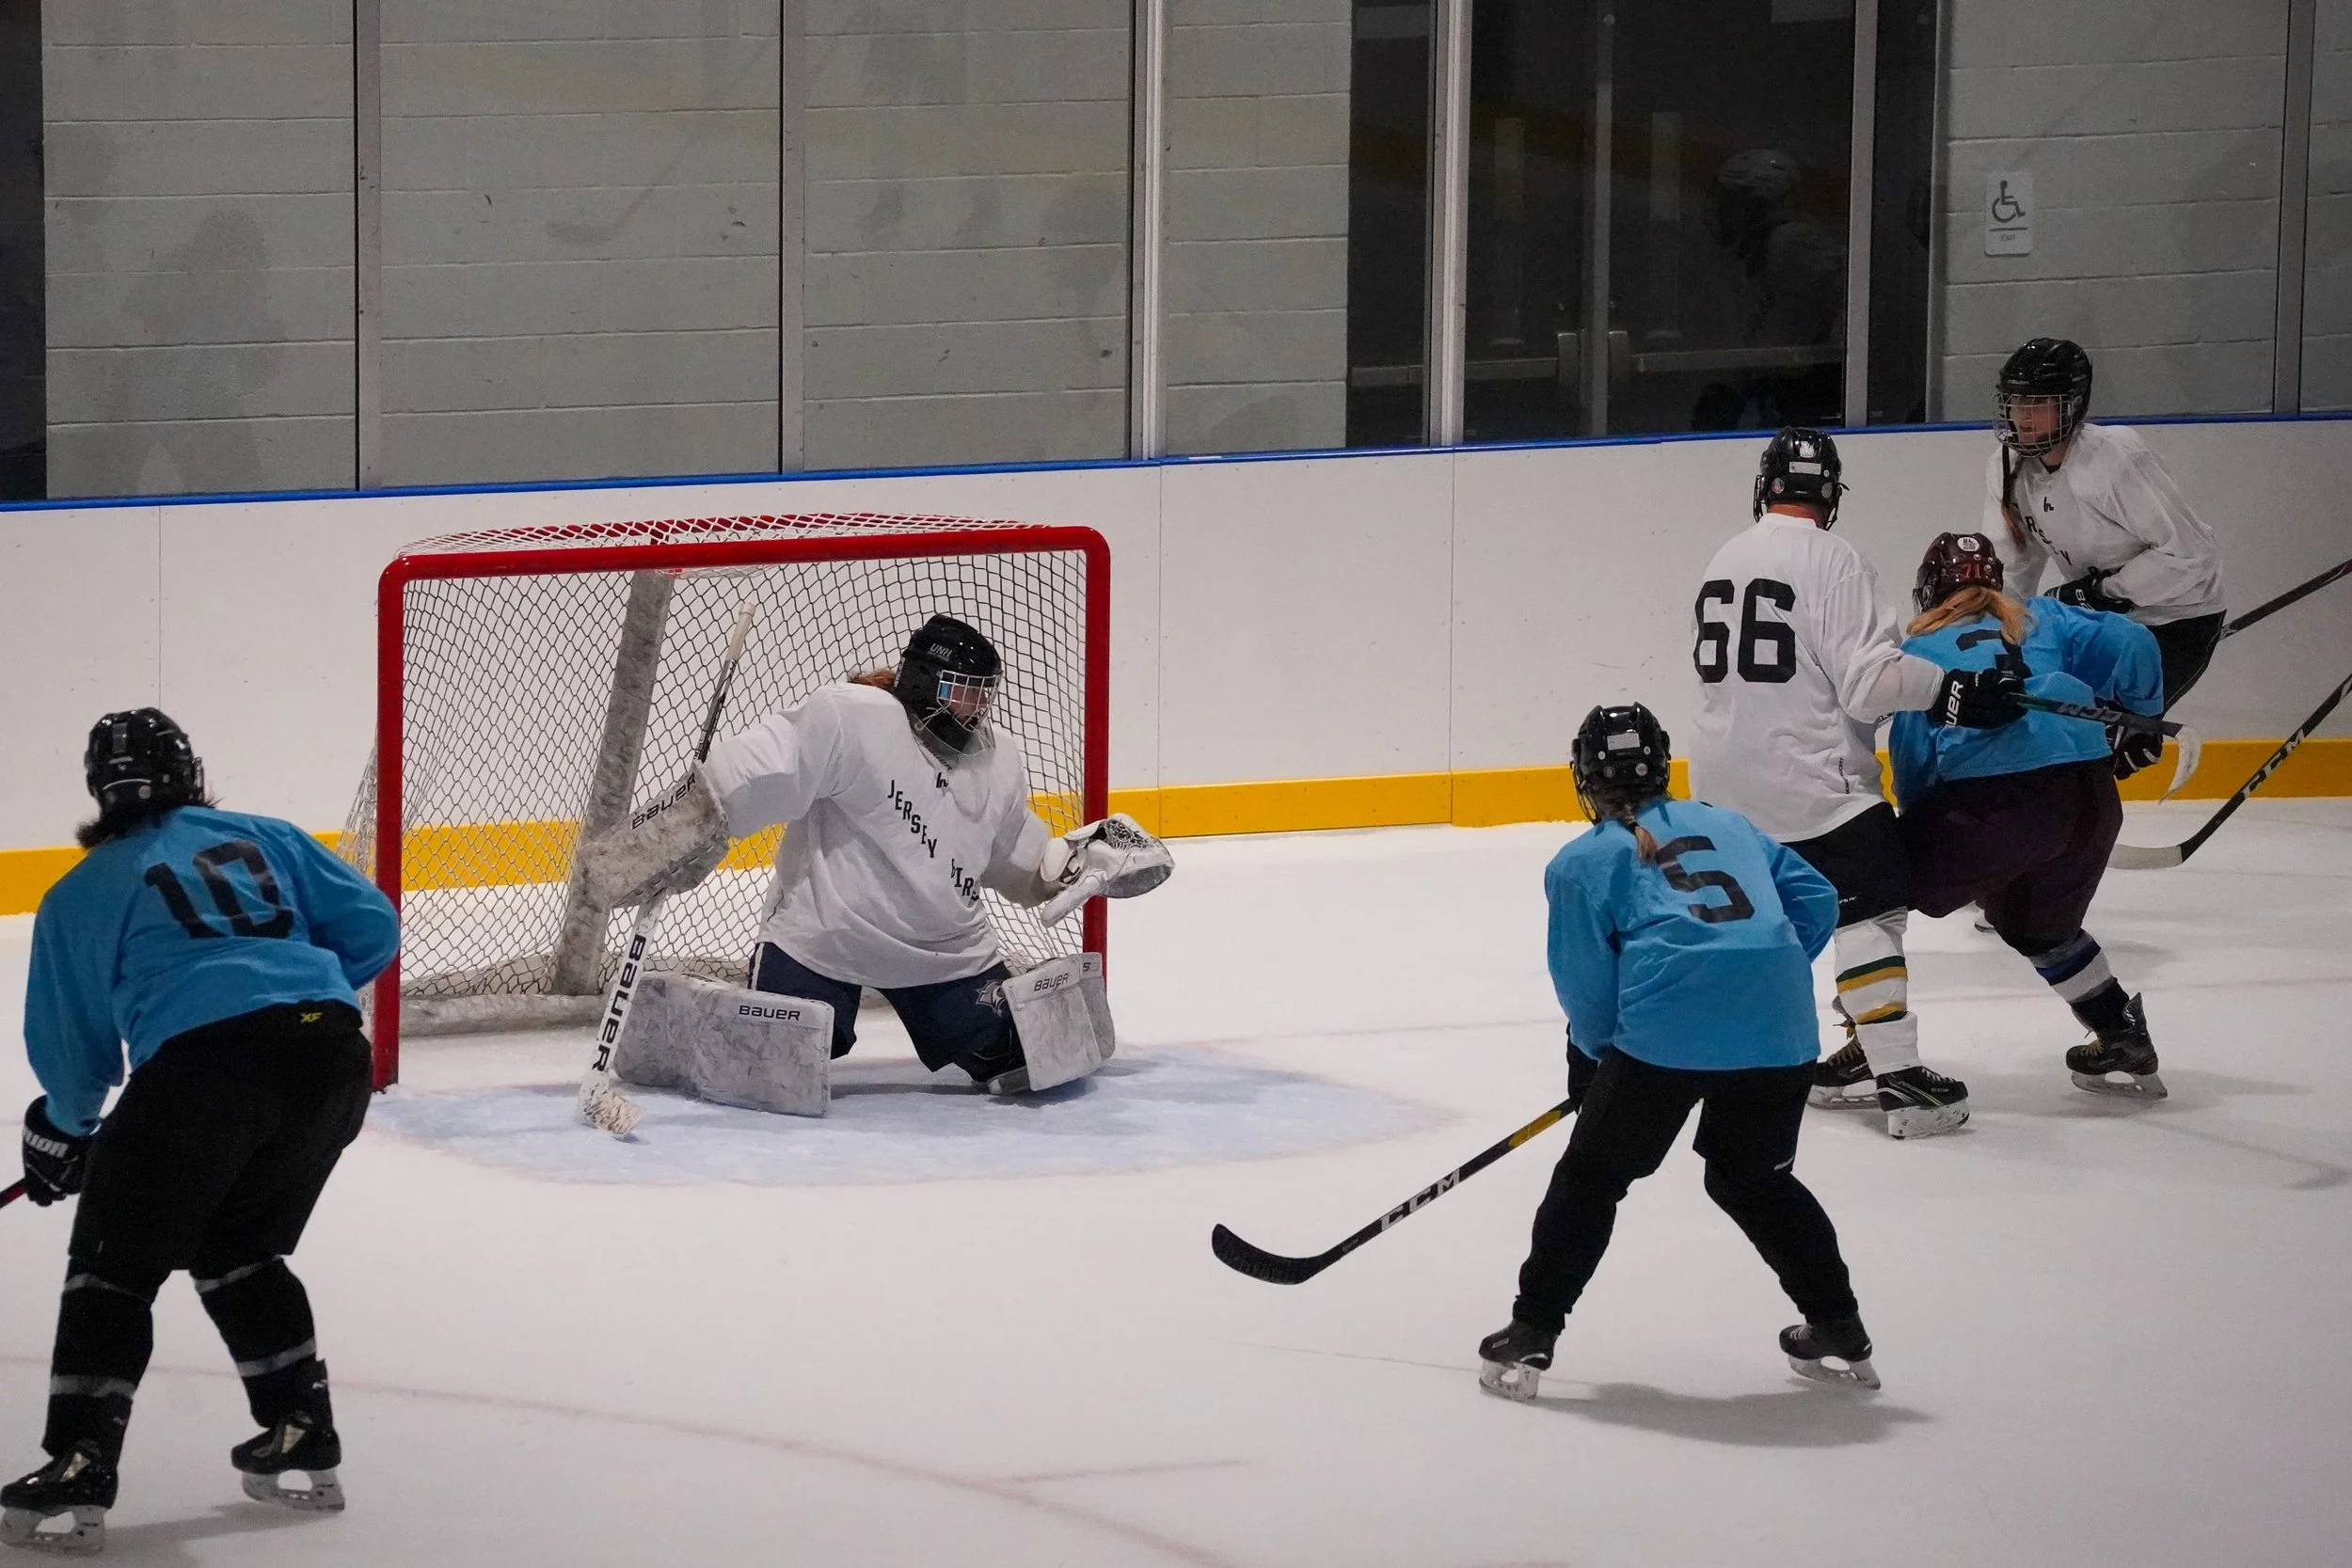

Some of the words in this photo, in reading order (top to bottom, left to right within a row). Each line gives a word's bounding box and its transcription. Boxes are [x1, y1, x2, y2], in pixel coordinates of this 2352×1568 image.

[1693, 578, 1796, 683] 66
[631, 772, 696, 831] BAUER
[887, 779, 937, 858] JERSEY
[144, 840, 294, 939] 10
[1655, 835, 1756, 925] 5
[592, 934, 647, 1071] BAUER
[739, 1005, 801, 1022] BAUER
[1034, 973, 1069, 992] BAUER
[1381, 1168, 1460, 1232] CCM
